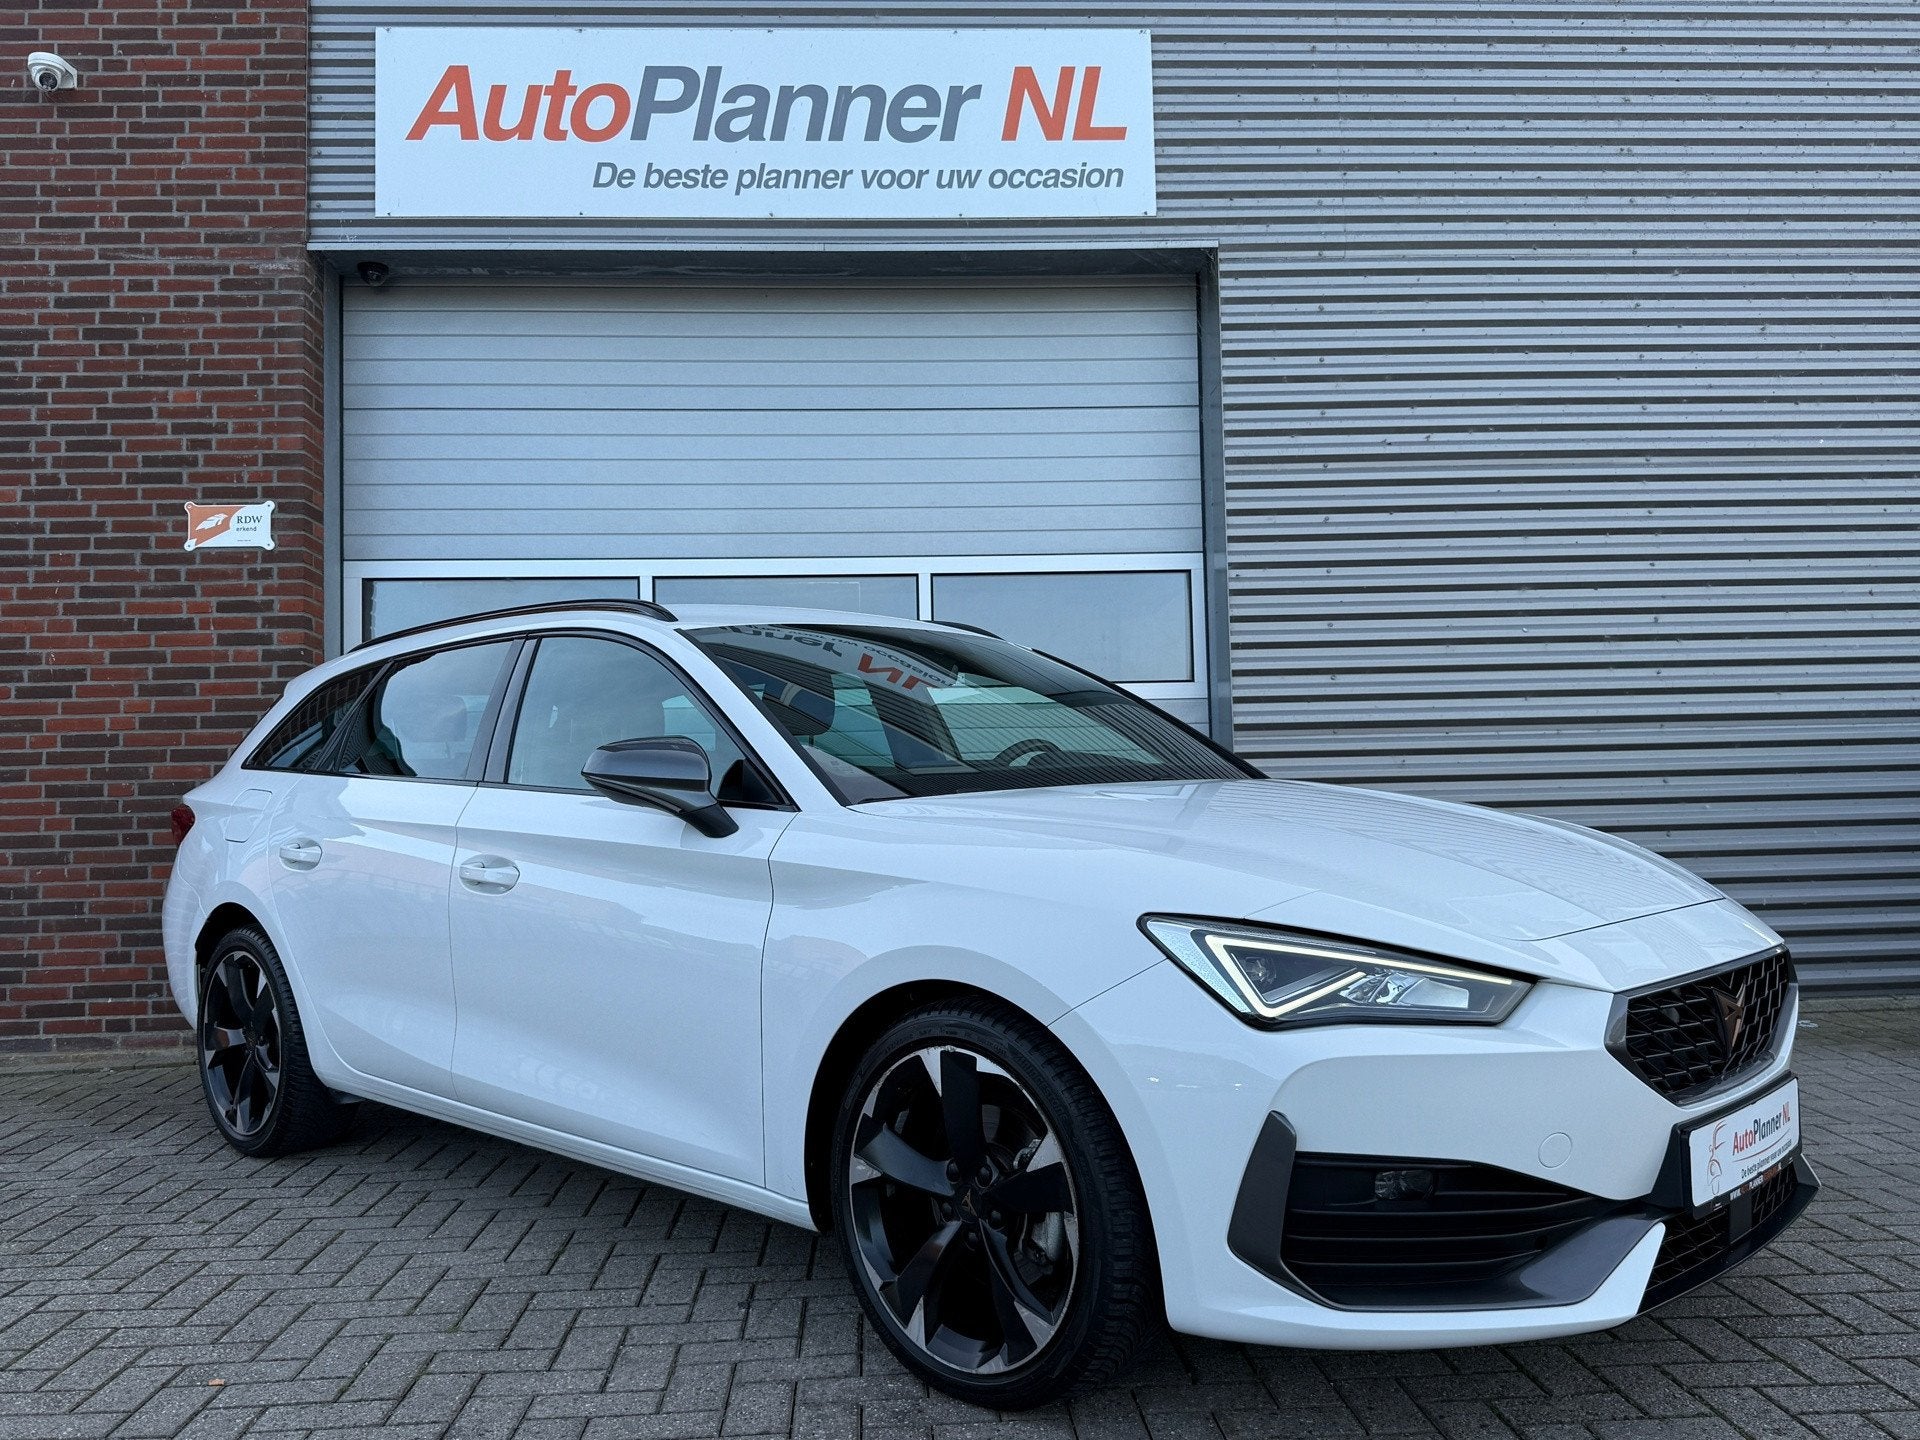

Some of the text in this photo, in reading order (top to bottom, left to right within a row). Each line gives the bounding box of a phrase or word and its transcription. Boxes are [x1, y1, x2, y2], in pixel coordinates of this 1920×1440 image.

[406, 65, 1127, 143] AutoPlanner NL
[593, 162, 1124, 196] De beste planner voor uw occasion
[237, 515, 263, 524] RDW
[1733, 1112, 1782, 1156] AutoPlanner
[1782, 1101, 1791, 1126] NL
[1741, 1168, 1747, 1179] De
